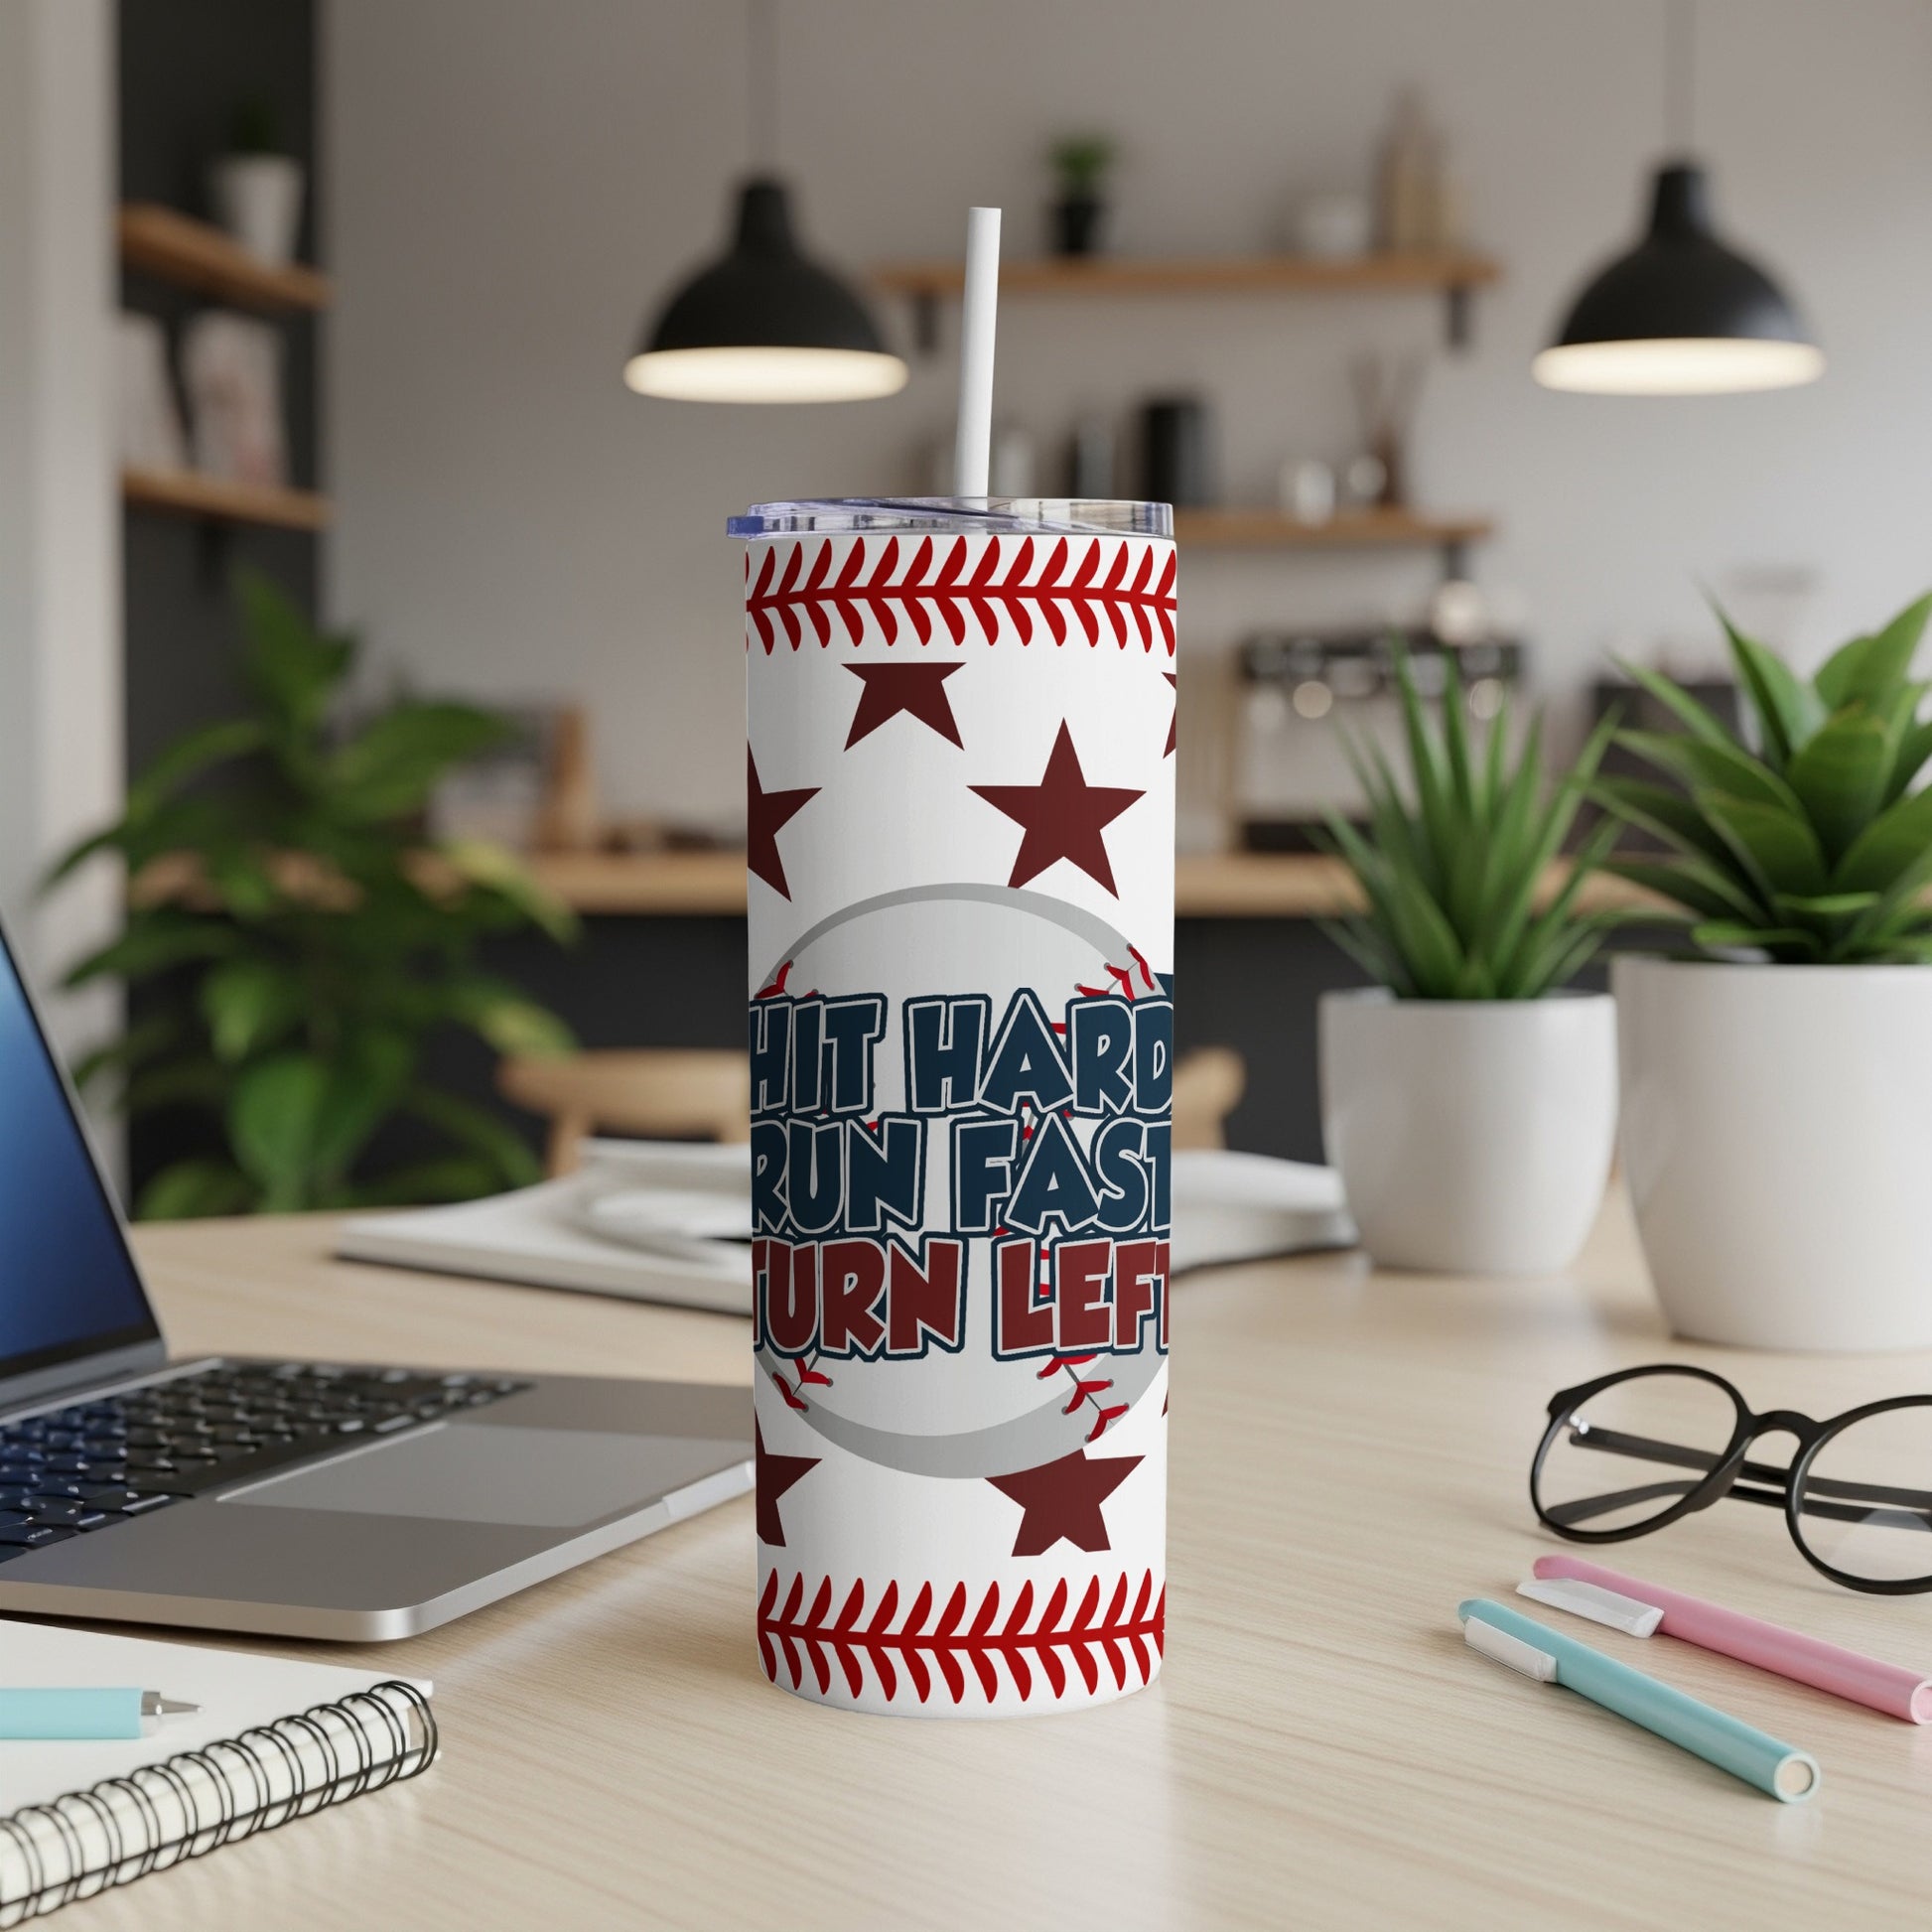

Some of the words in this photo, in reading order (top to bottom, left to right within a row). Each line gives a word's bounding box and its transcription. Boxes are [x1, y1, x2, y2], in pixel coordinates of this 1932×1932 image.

[750, 994, 887, 1115] HIT
[904, 989, 1173, 1115] HARD
[751, 1116, 925, 1234] RUN
